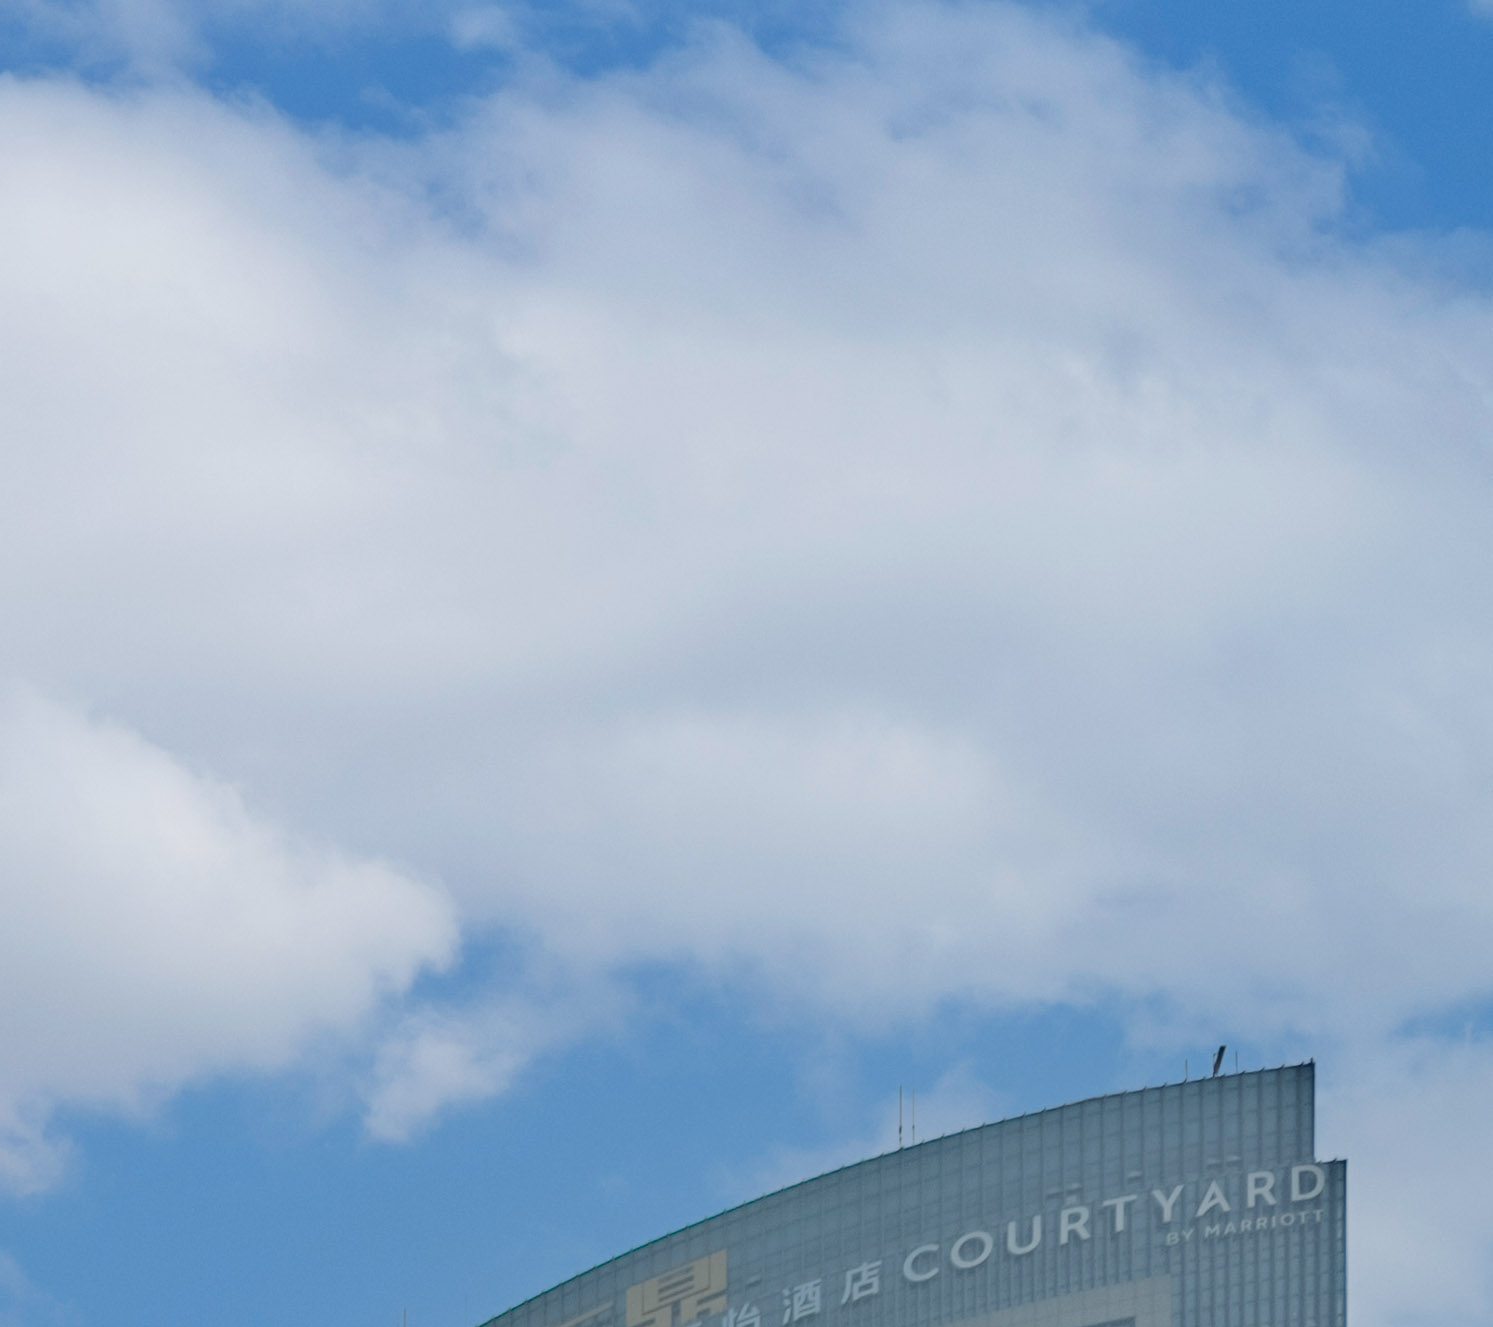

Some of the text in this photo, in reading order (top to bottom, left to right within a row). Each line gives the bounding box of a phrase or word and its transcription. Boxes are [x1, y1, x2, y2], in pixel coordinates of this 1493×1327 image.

[903, 1164, 1325, 1282] COURTYARD
[1166, 1209, 1325, 1246] BY MARRIOTT
